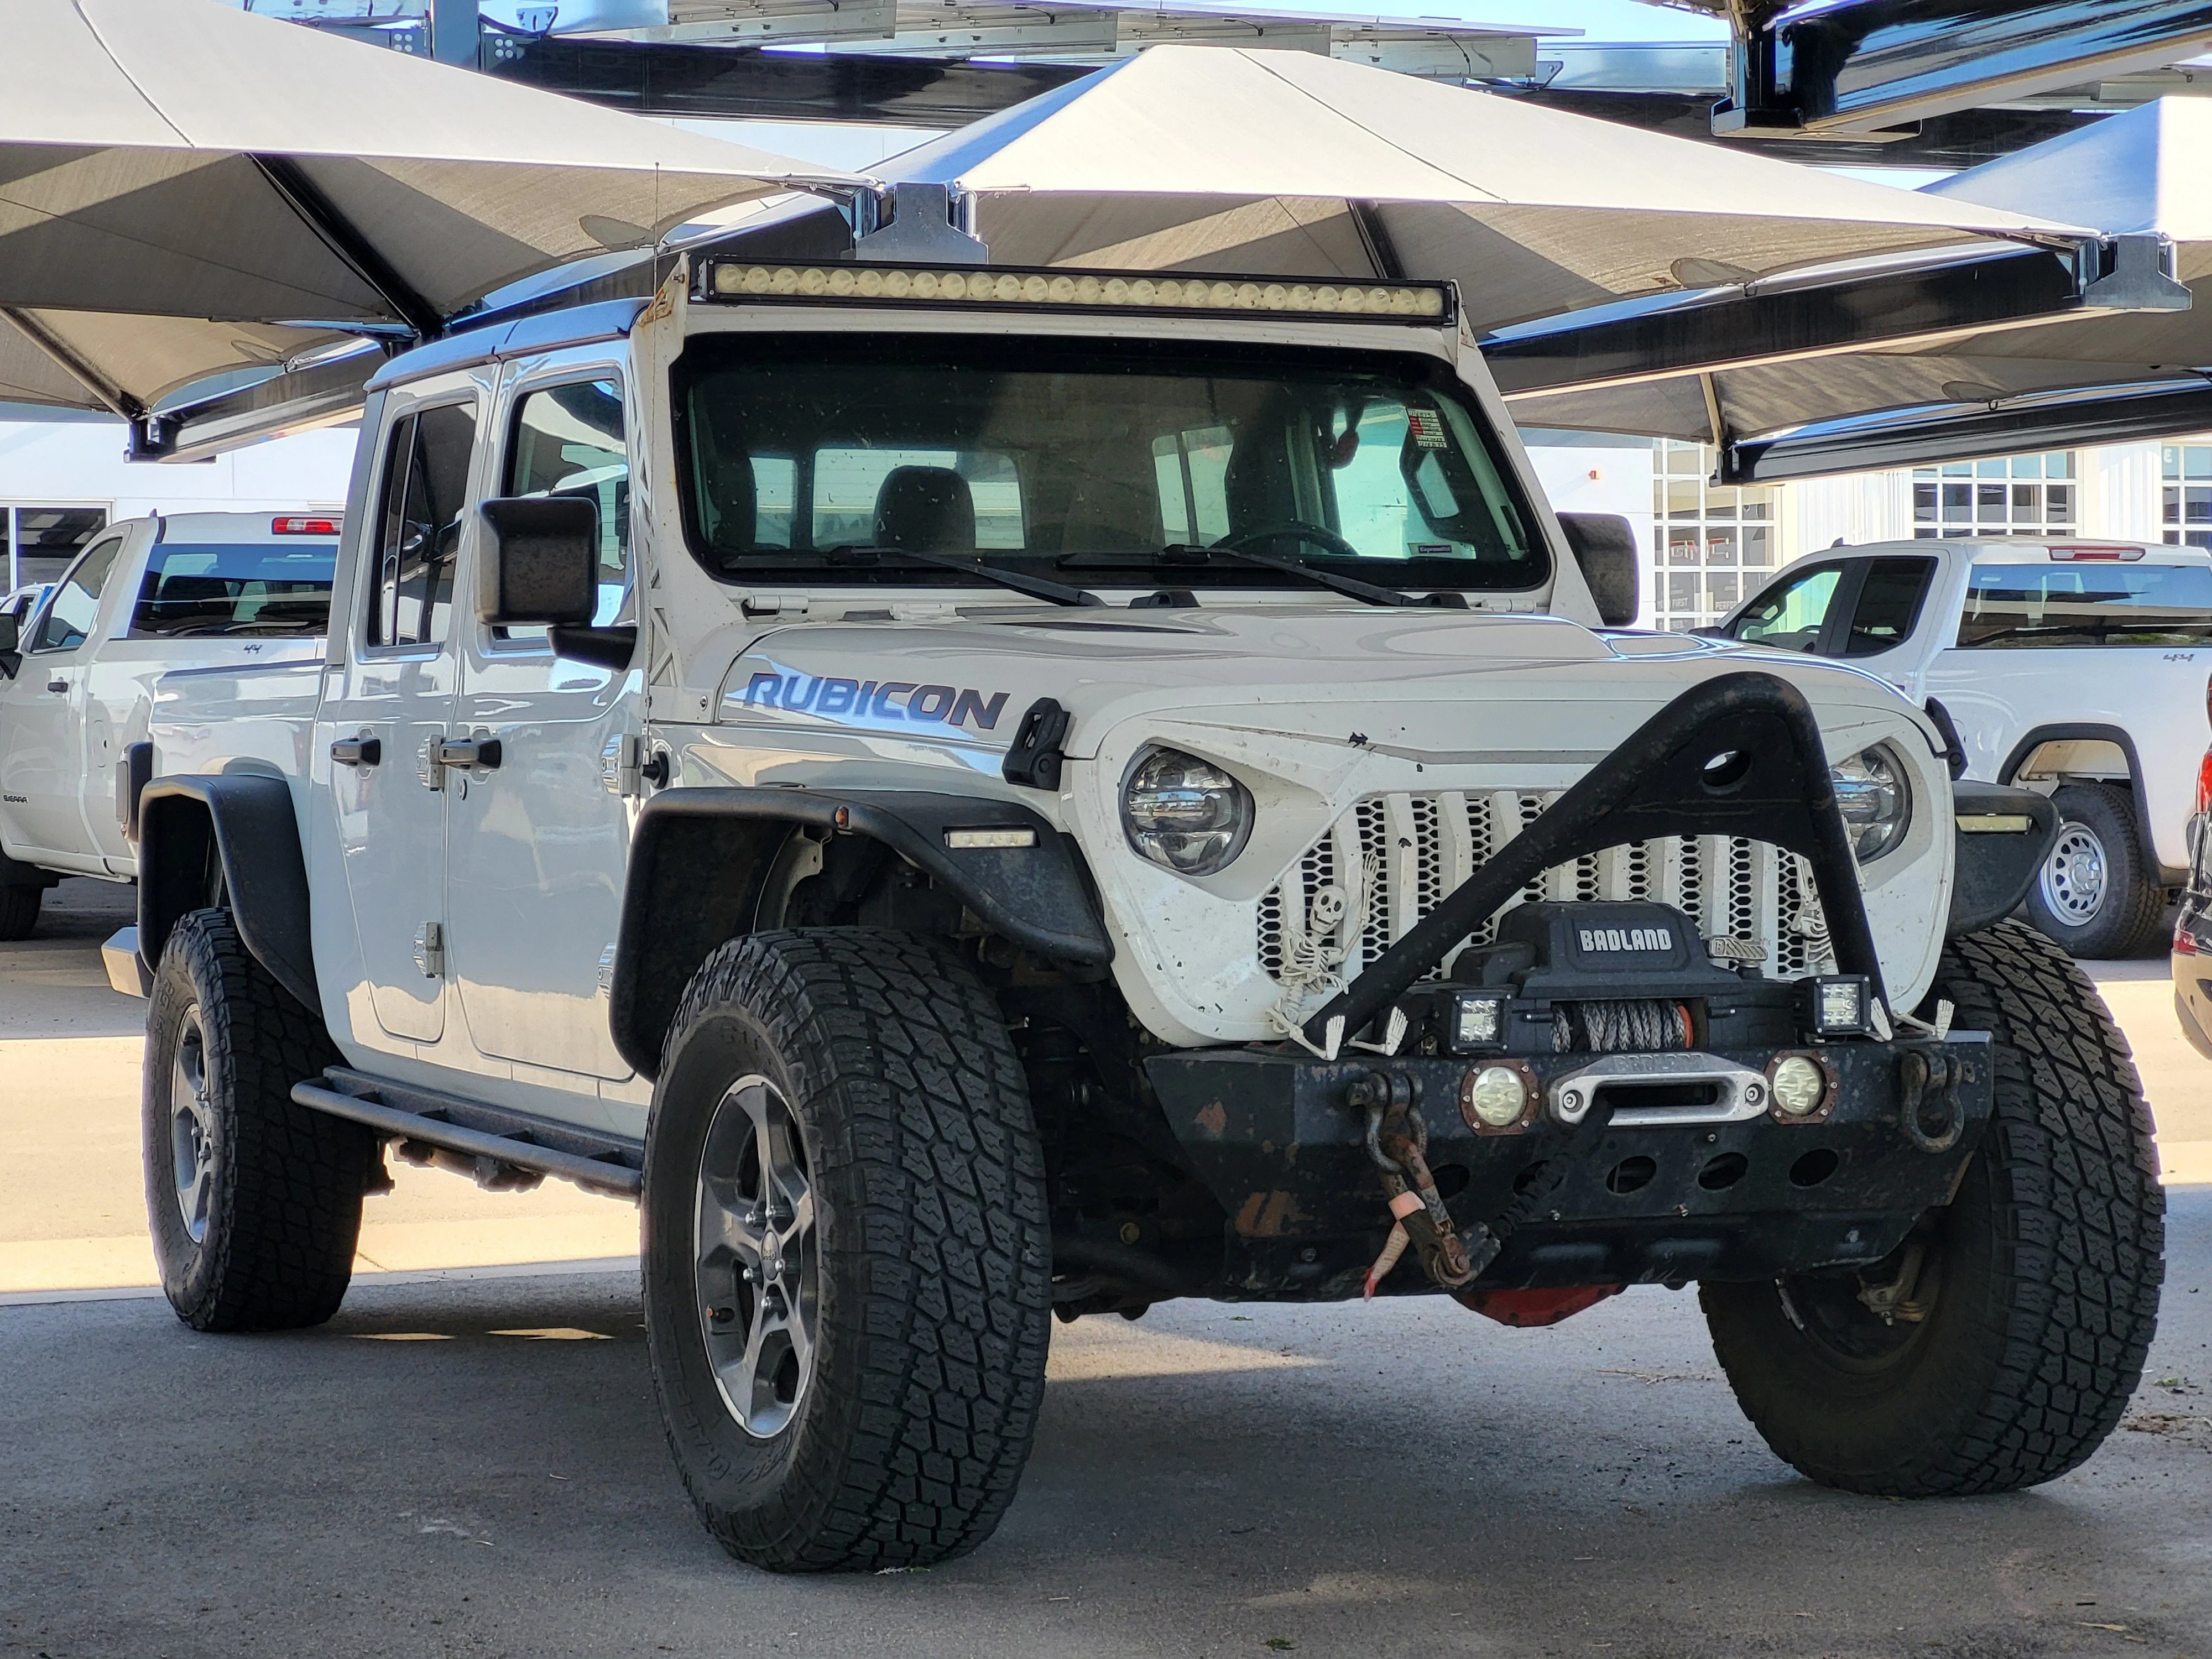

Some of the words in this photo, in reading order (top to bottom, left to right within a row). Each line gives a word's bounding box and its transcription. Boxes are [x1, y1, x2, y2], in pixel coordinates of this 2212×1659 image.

[1670, 538, 1730, 560] GMC
[743, 672, 1011, 730] RUBICON
[3, 795, 28, 804] SIERRA
[1579, 928, 1672, 952] BADLAND
